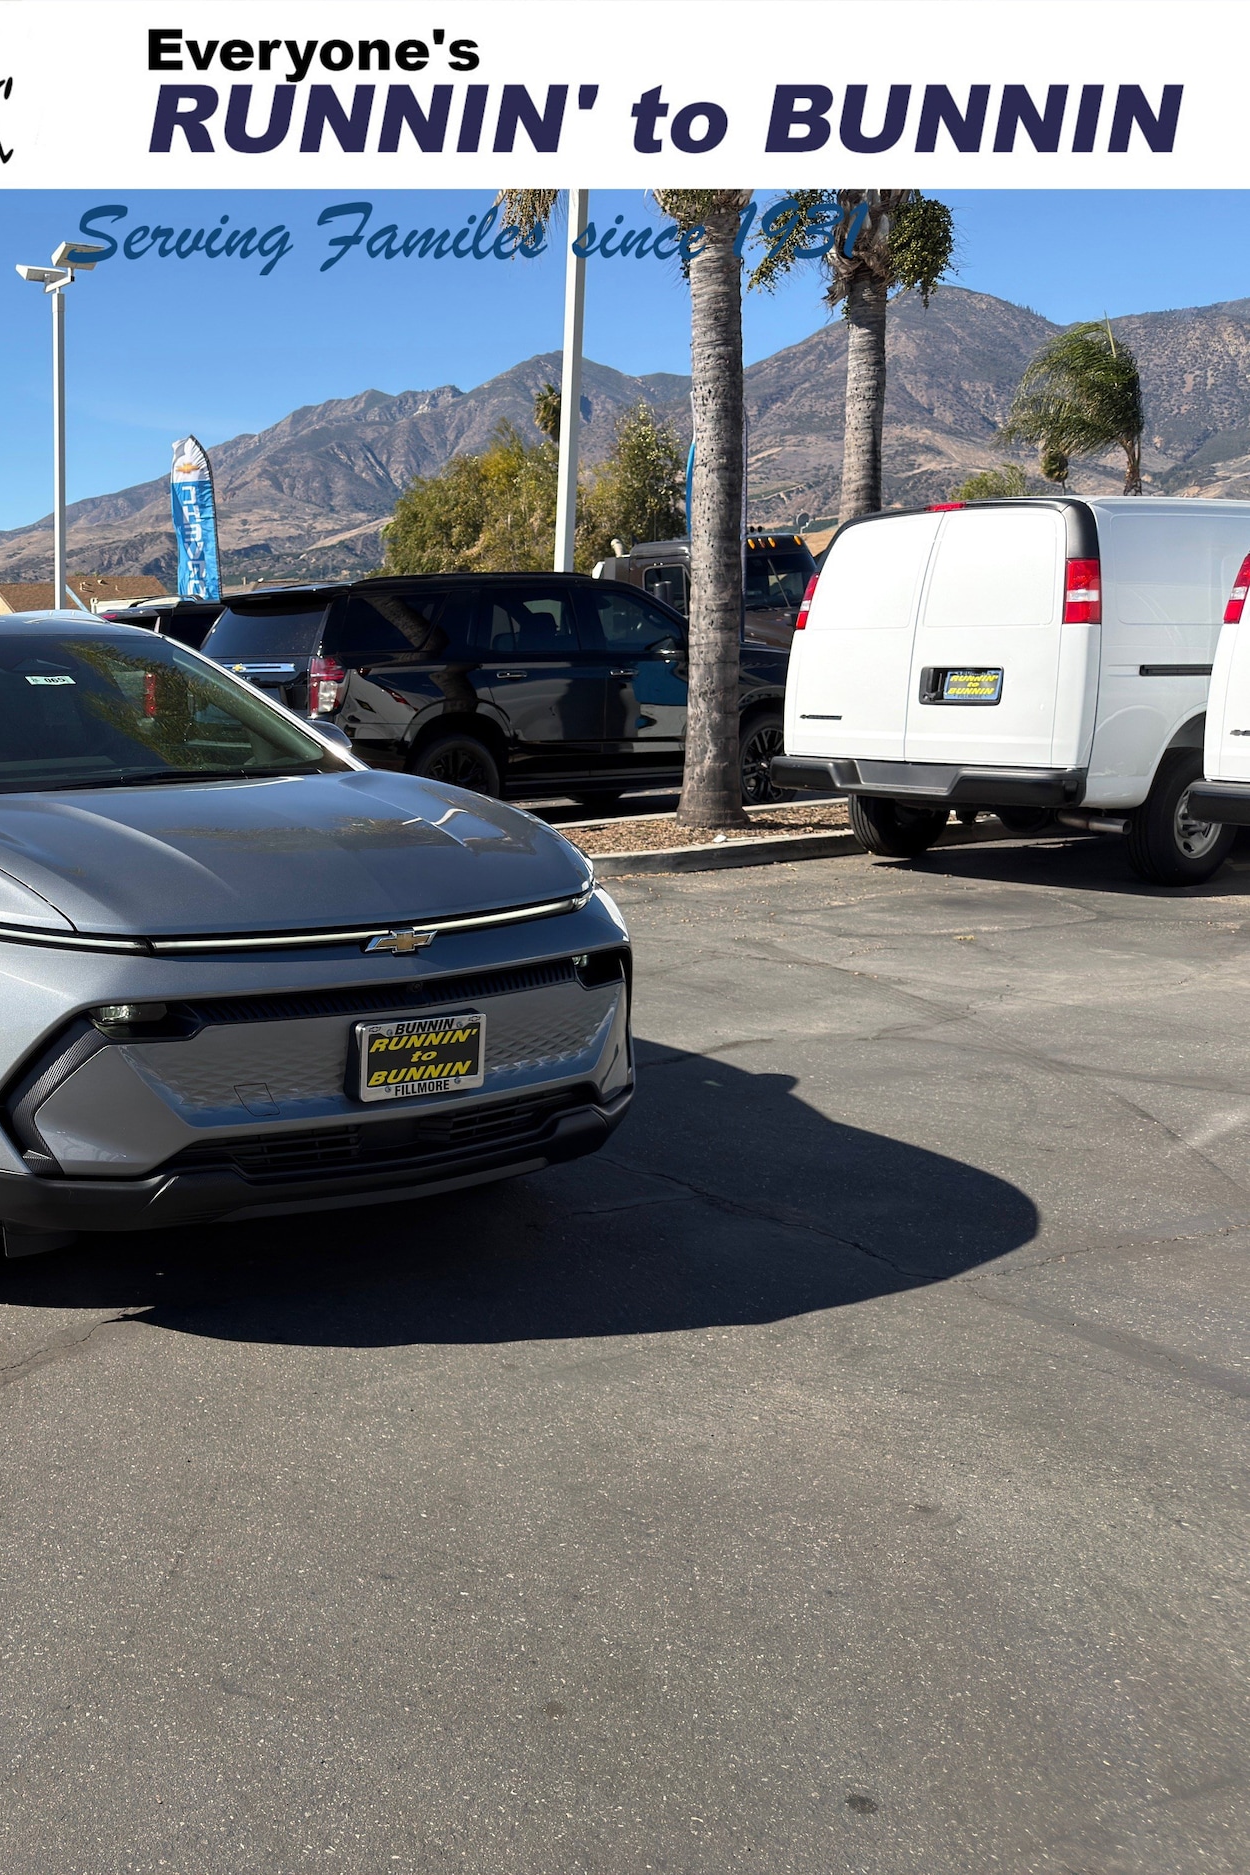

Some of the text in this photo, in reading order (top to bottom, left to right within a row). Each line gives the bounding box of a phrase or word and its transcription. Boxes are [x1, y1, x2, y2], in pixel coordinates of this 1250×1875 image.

[947, 687, 996, 695] BUNNIN
[394, 1018, 455, 1035] BUNNIN
[369, 1028, 478, 1053] RUNNIN'
[410, 1050, 438, 1063] to
[367, 1060, 473, 1087] BUNNIN
[394, 1080, 450, 1097] FILLMORE
